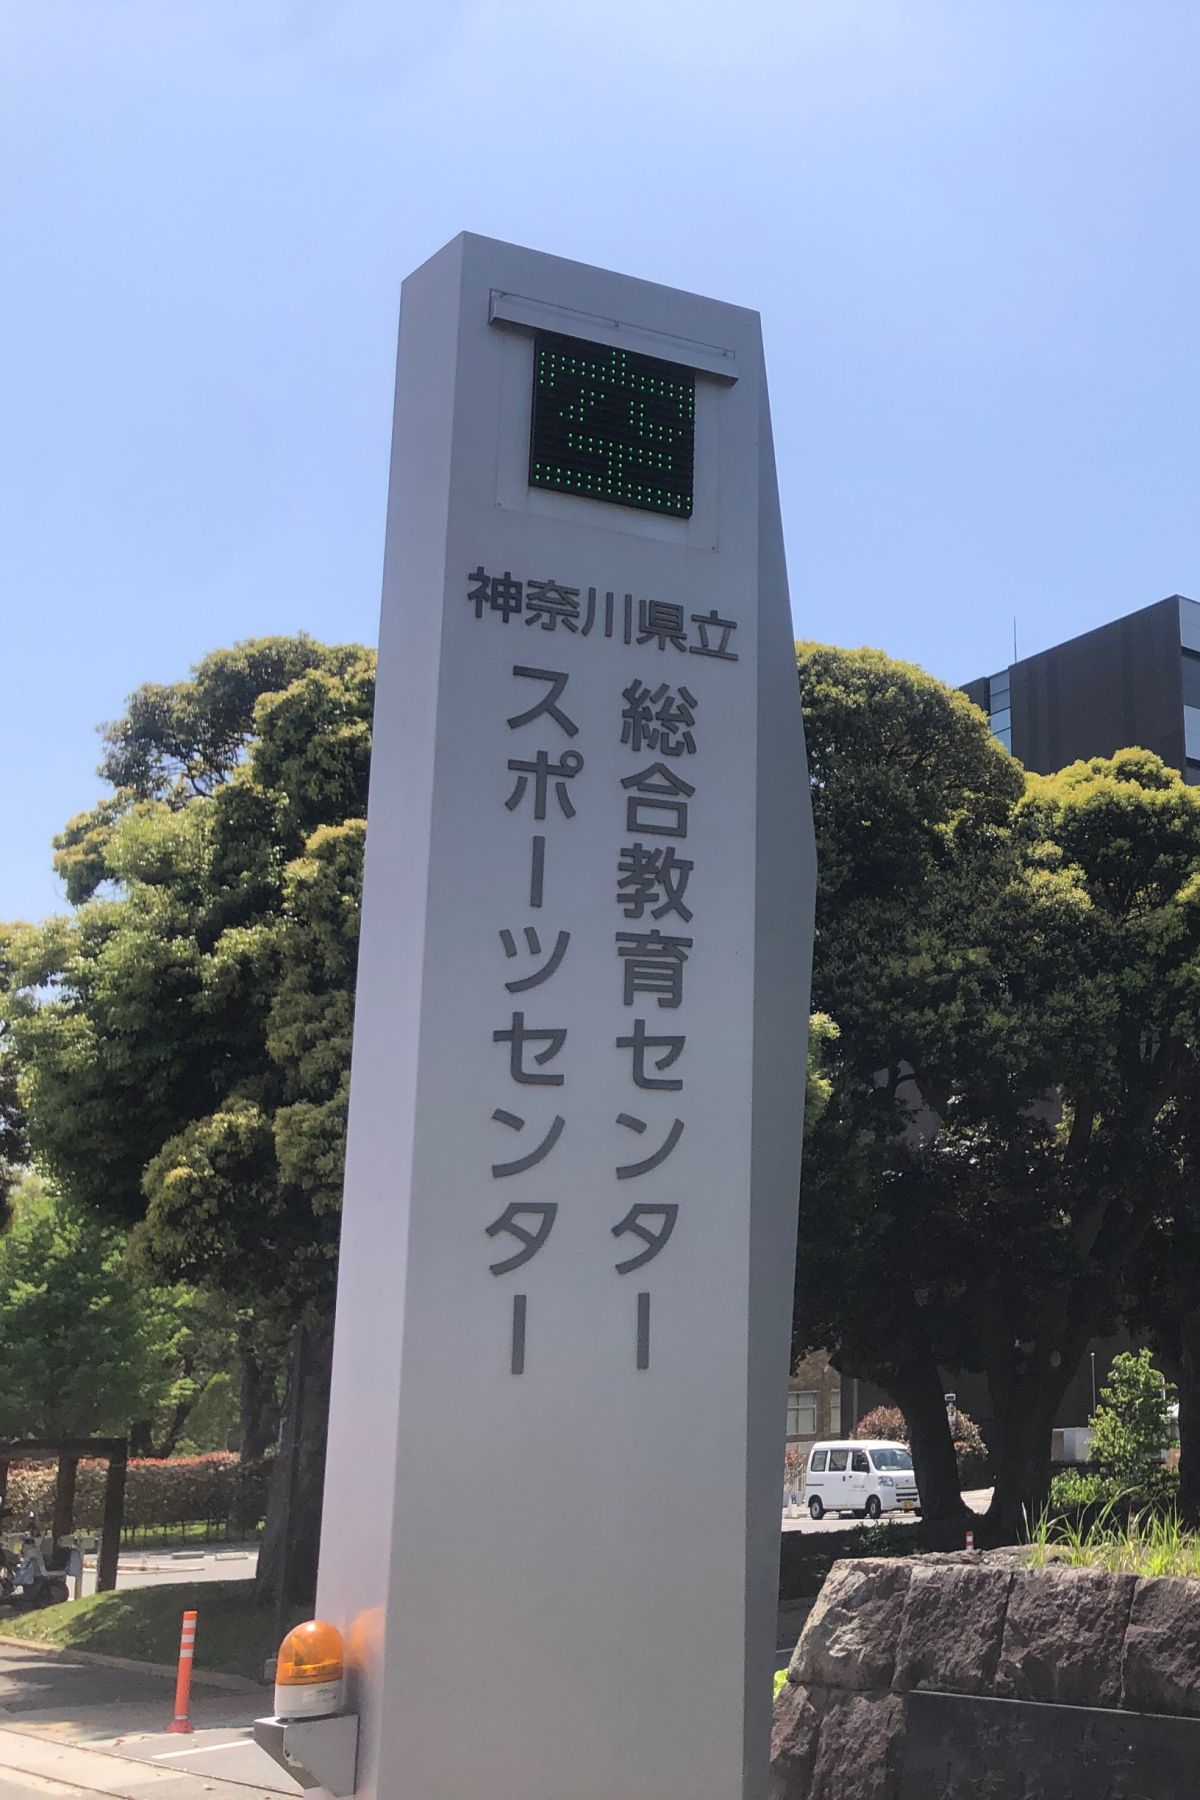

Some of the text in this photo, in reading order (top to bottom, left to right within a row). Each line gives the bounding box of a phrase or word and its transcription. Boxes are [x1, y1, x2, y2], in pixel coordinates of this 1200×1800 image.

[466, 565, 739, 662] 神奈川県立
[533, 350, 693, 510] 空
[485, 664, 585, 1375] スポーツセンター
[611, 678, 698, 1370] 総合教育センター
